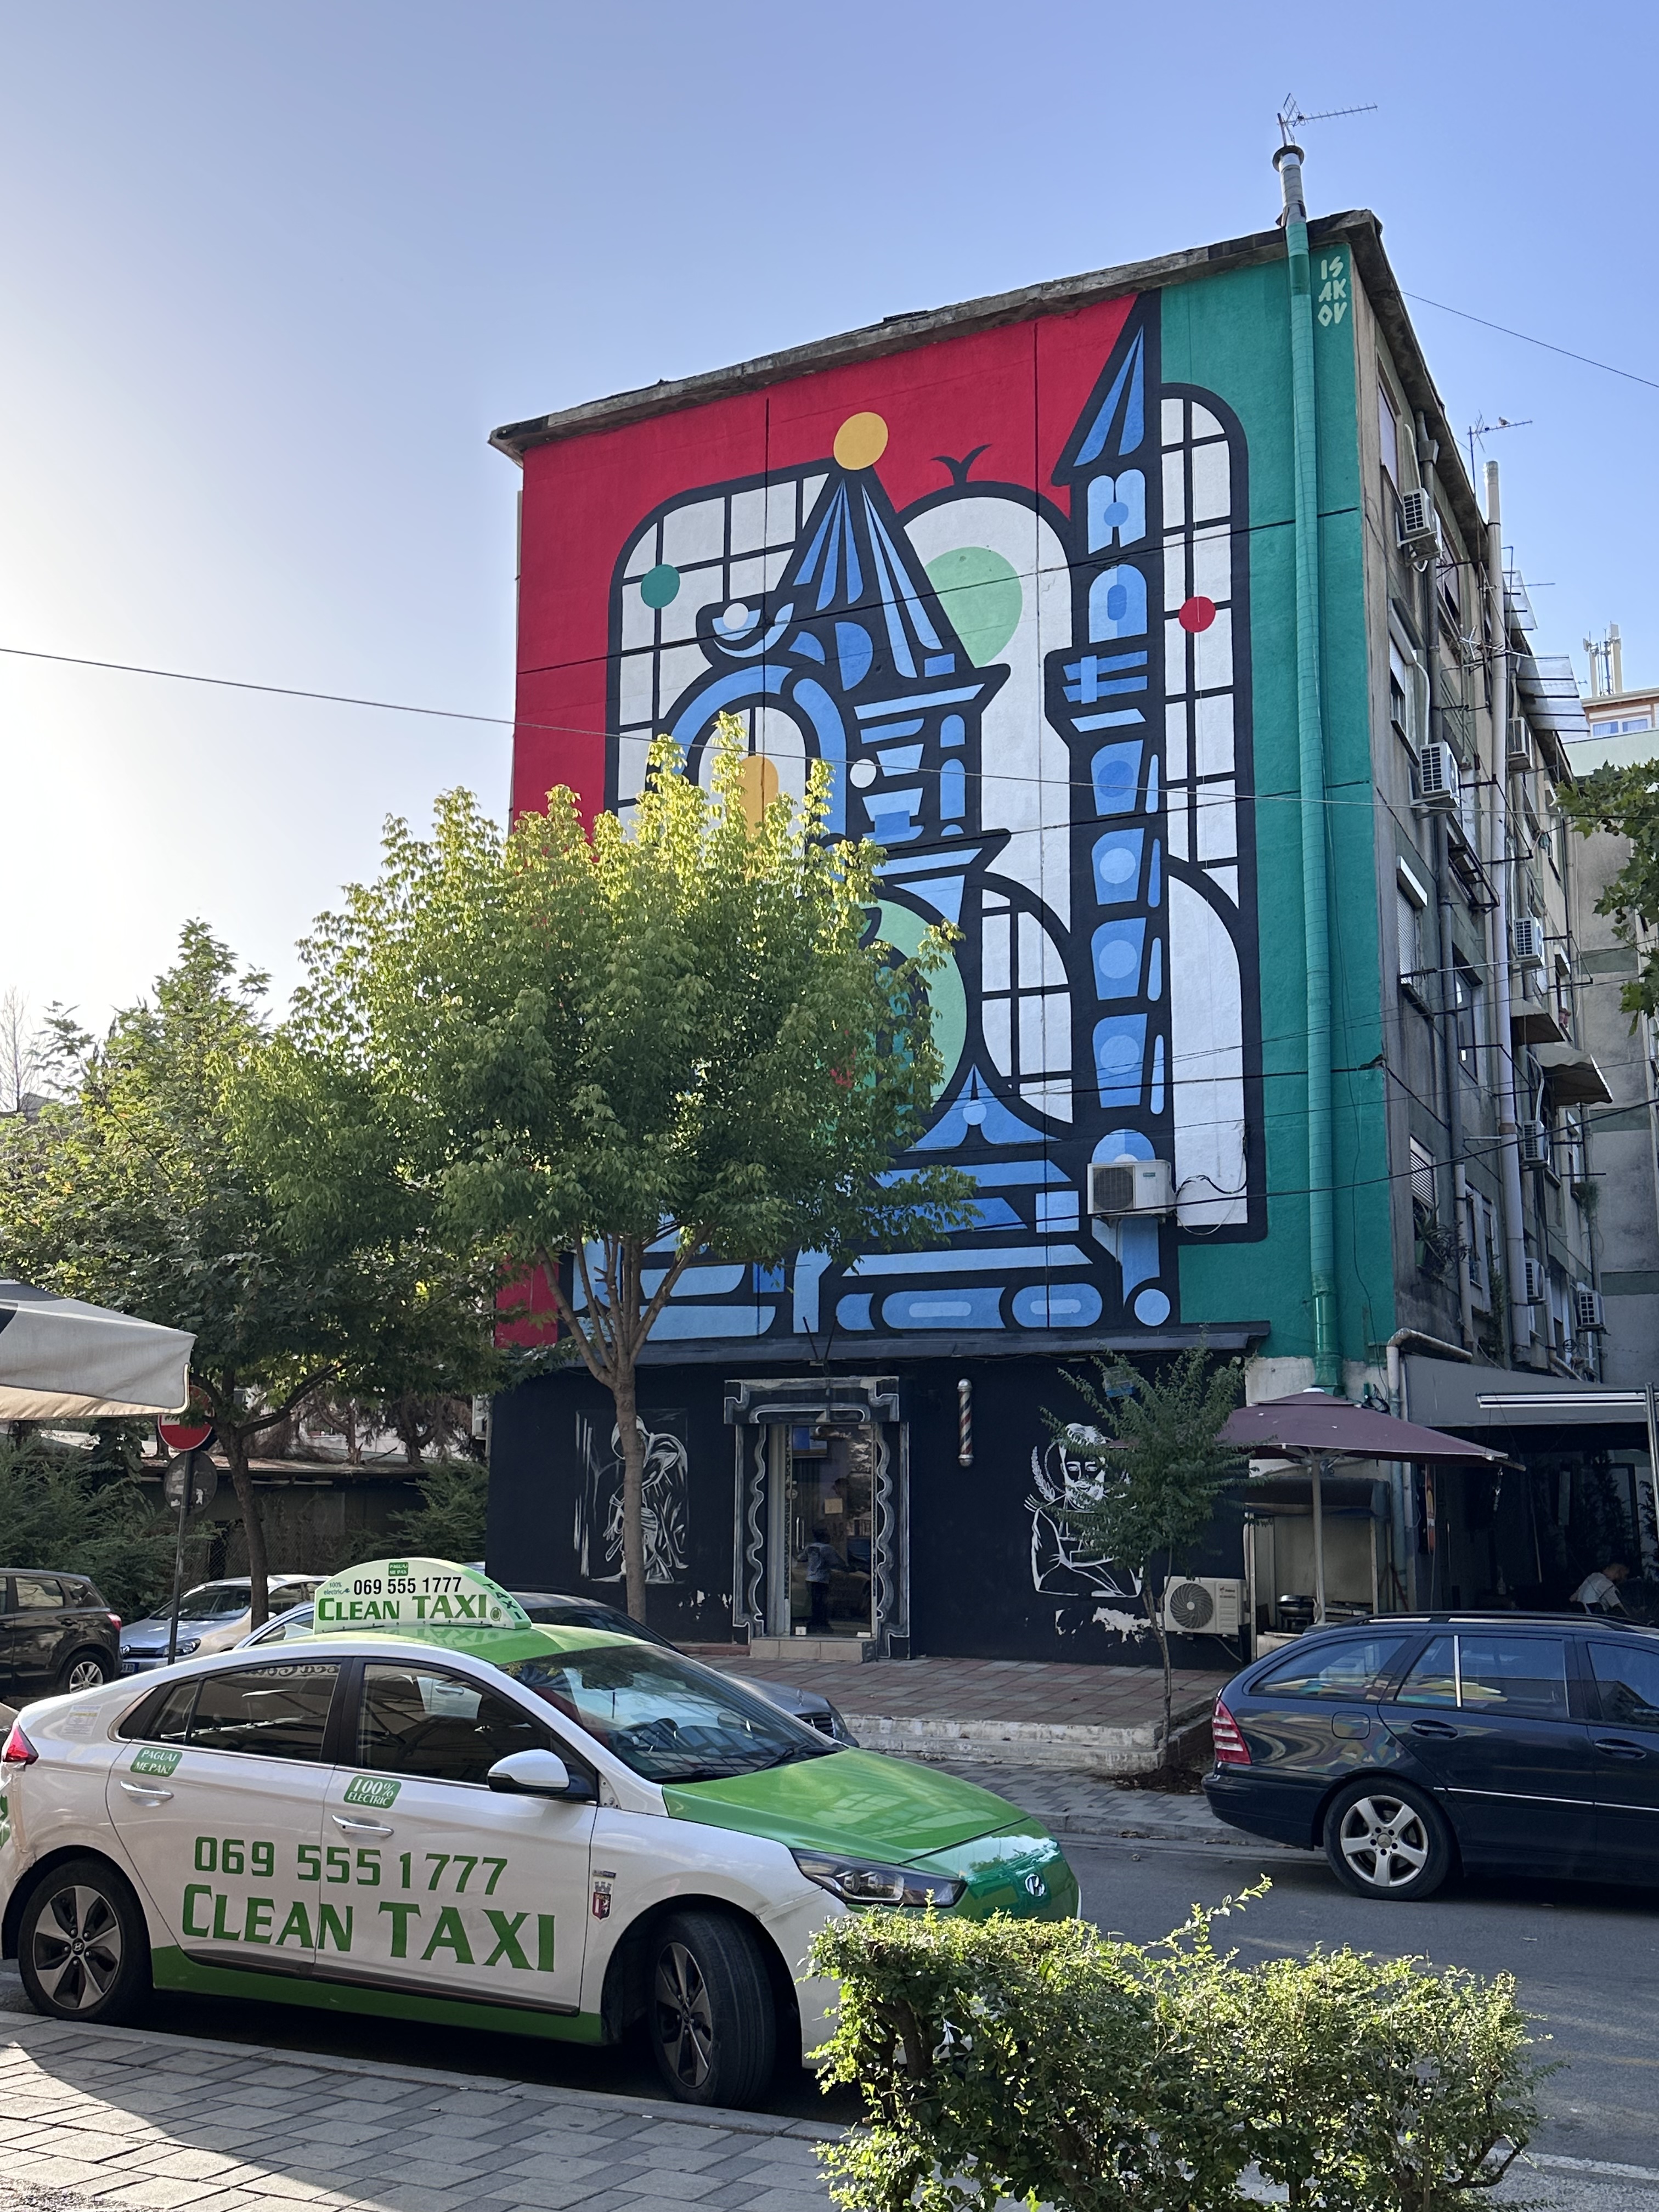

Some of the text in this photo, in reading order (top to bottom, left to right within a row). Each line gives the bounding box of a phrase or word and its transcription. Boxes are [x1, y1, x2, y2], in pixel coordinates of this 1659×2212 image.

[1321, 256, 1344, 280] IS
[1318, 278, 1347, 302] AK
[1317, 302, 1347, 327] OV
[354, 1576, 462, 1595] 069 555 1777
[319, 1598, 399, 1621] CLEAN
[412, 1594, 487, 1619] TAXI
[482, 1583, 522, 1620] TAXI
[134, 1762, 150, 1771] ME
[141, 1750, 178, 1762] PAGUAJ
[347, 1792, 390, 1805] ELECTRIC
[353, 1779, 395, 1797] 100%
[195, 1836, 508, 1895] 069 555 1777
[182, 1884, 555, 1972] CLEAN TAXI
